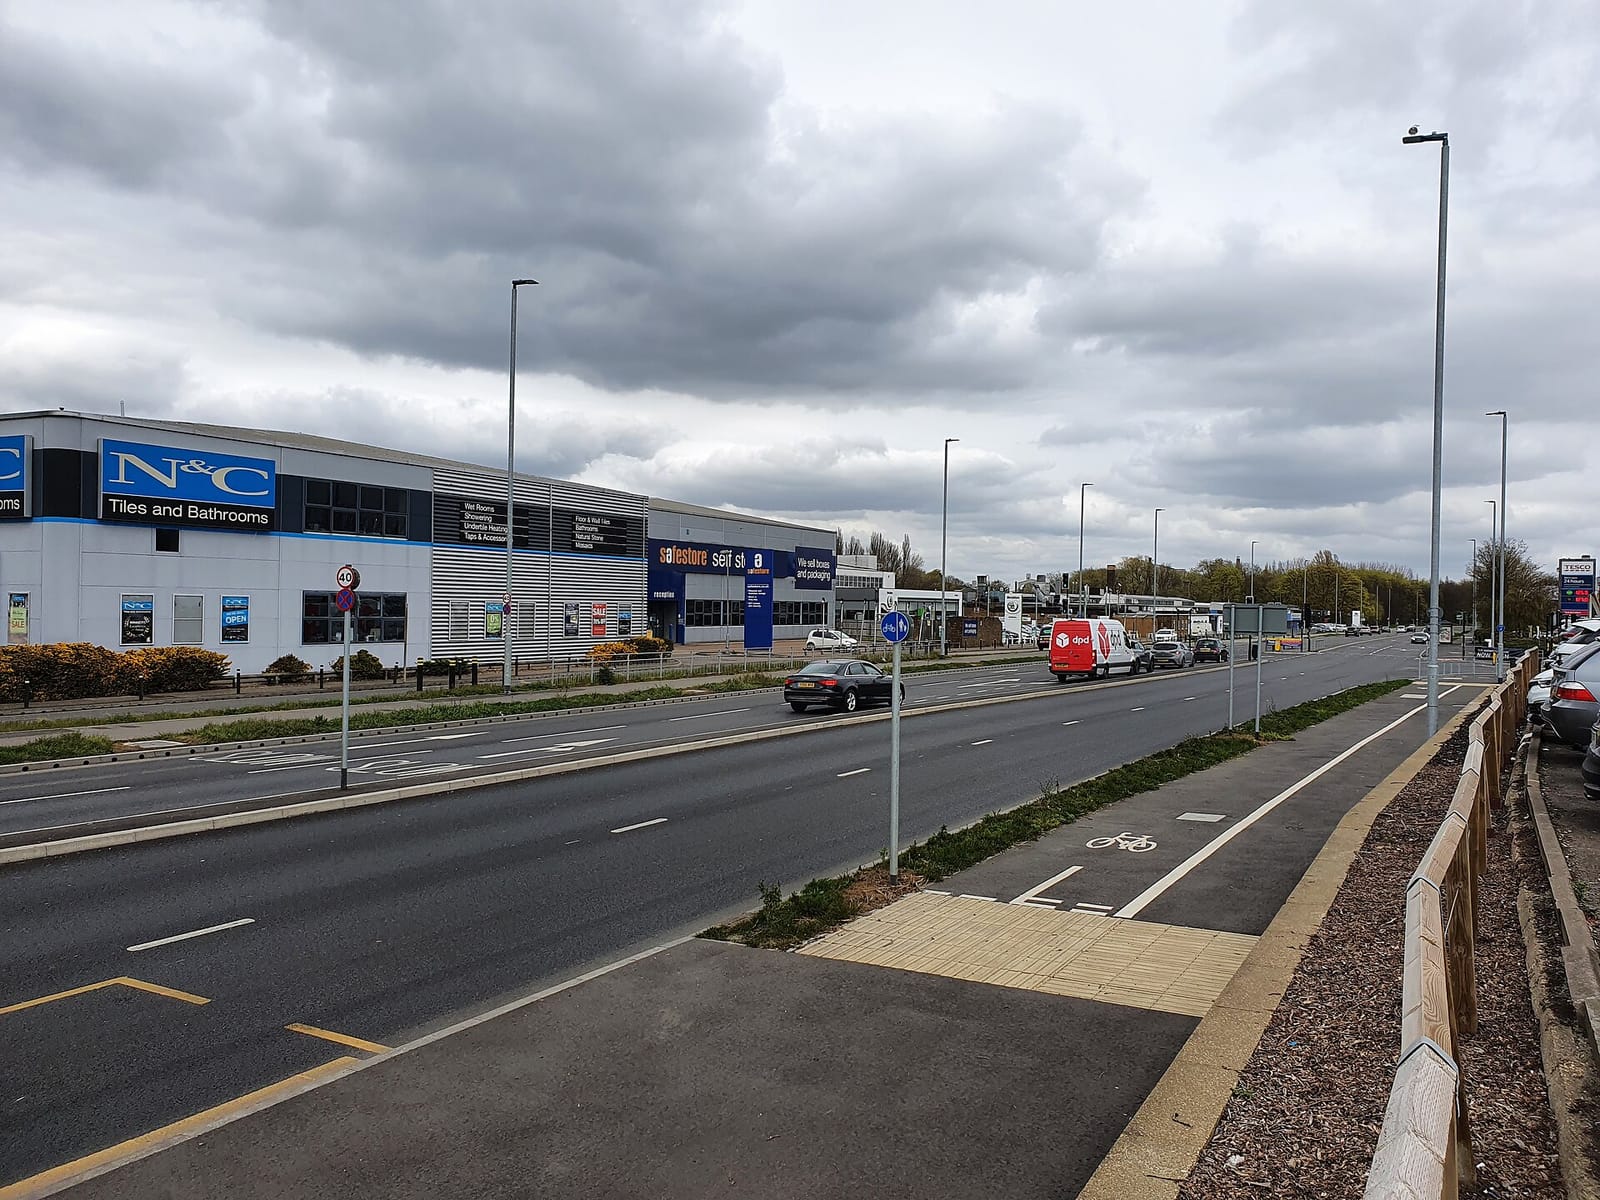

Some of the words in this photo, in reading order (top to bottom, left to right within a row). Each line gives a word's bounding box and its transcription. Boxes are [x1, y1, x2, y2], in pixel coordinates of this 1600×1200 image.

[108, 451, 269, 496] N&C
[108, 498, 147, 515] Tiles
[152, 504, 183, 518] and
[187, 505, 269, 524] Bathrooms
[464, 502, 475, 511] Wet
[476, 503, 495, 513] Rooms
[464, 512, 493, 523] Showering
[575, 515, 587, 523] Floor
[488, 525, 508, 534] Heating
[464, 532, 478, 541] Taps
[483, 534, 508, 542] Accessor
[659, 545, 708, 566] safestore
[797, 557, 807, 568] We
[807, 558, 816, 568] sell
[816, 559, 830, 569] boxes
[339, 572, 352, 582] 40
[796, 569, 807, 578] and
[807, 570, 831, 582] packaging
[225, 615, 248, 624] OPEN
[1072, 635, 1090, 646] dpd
